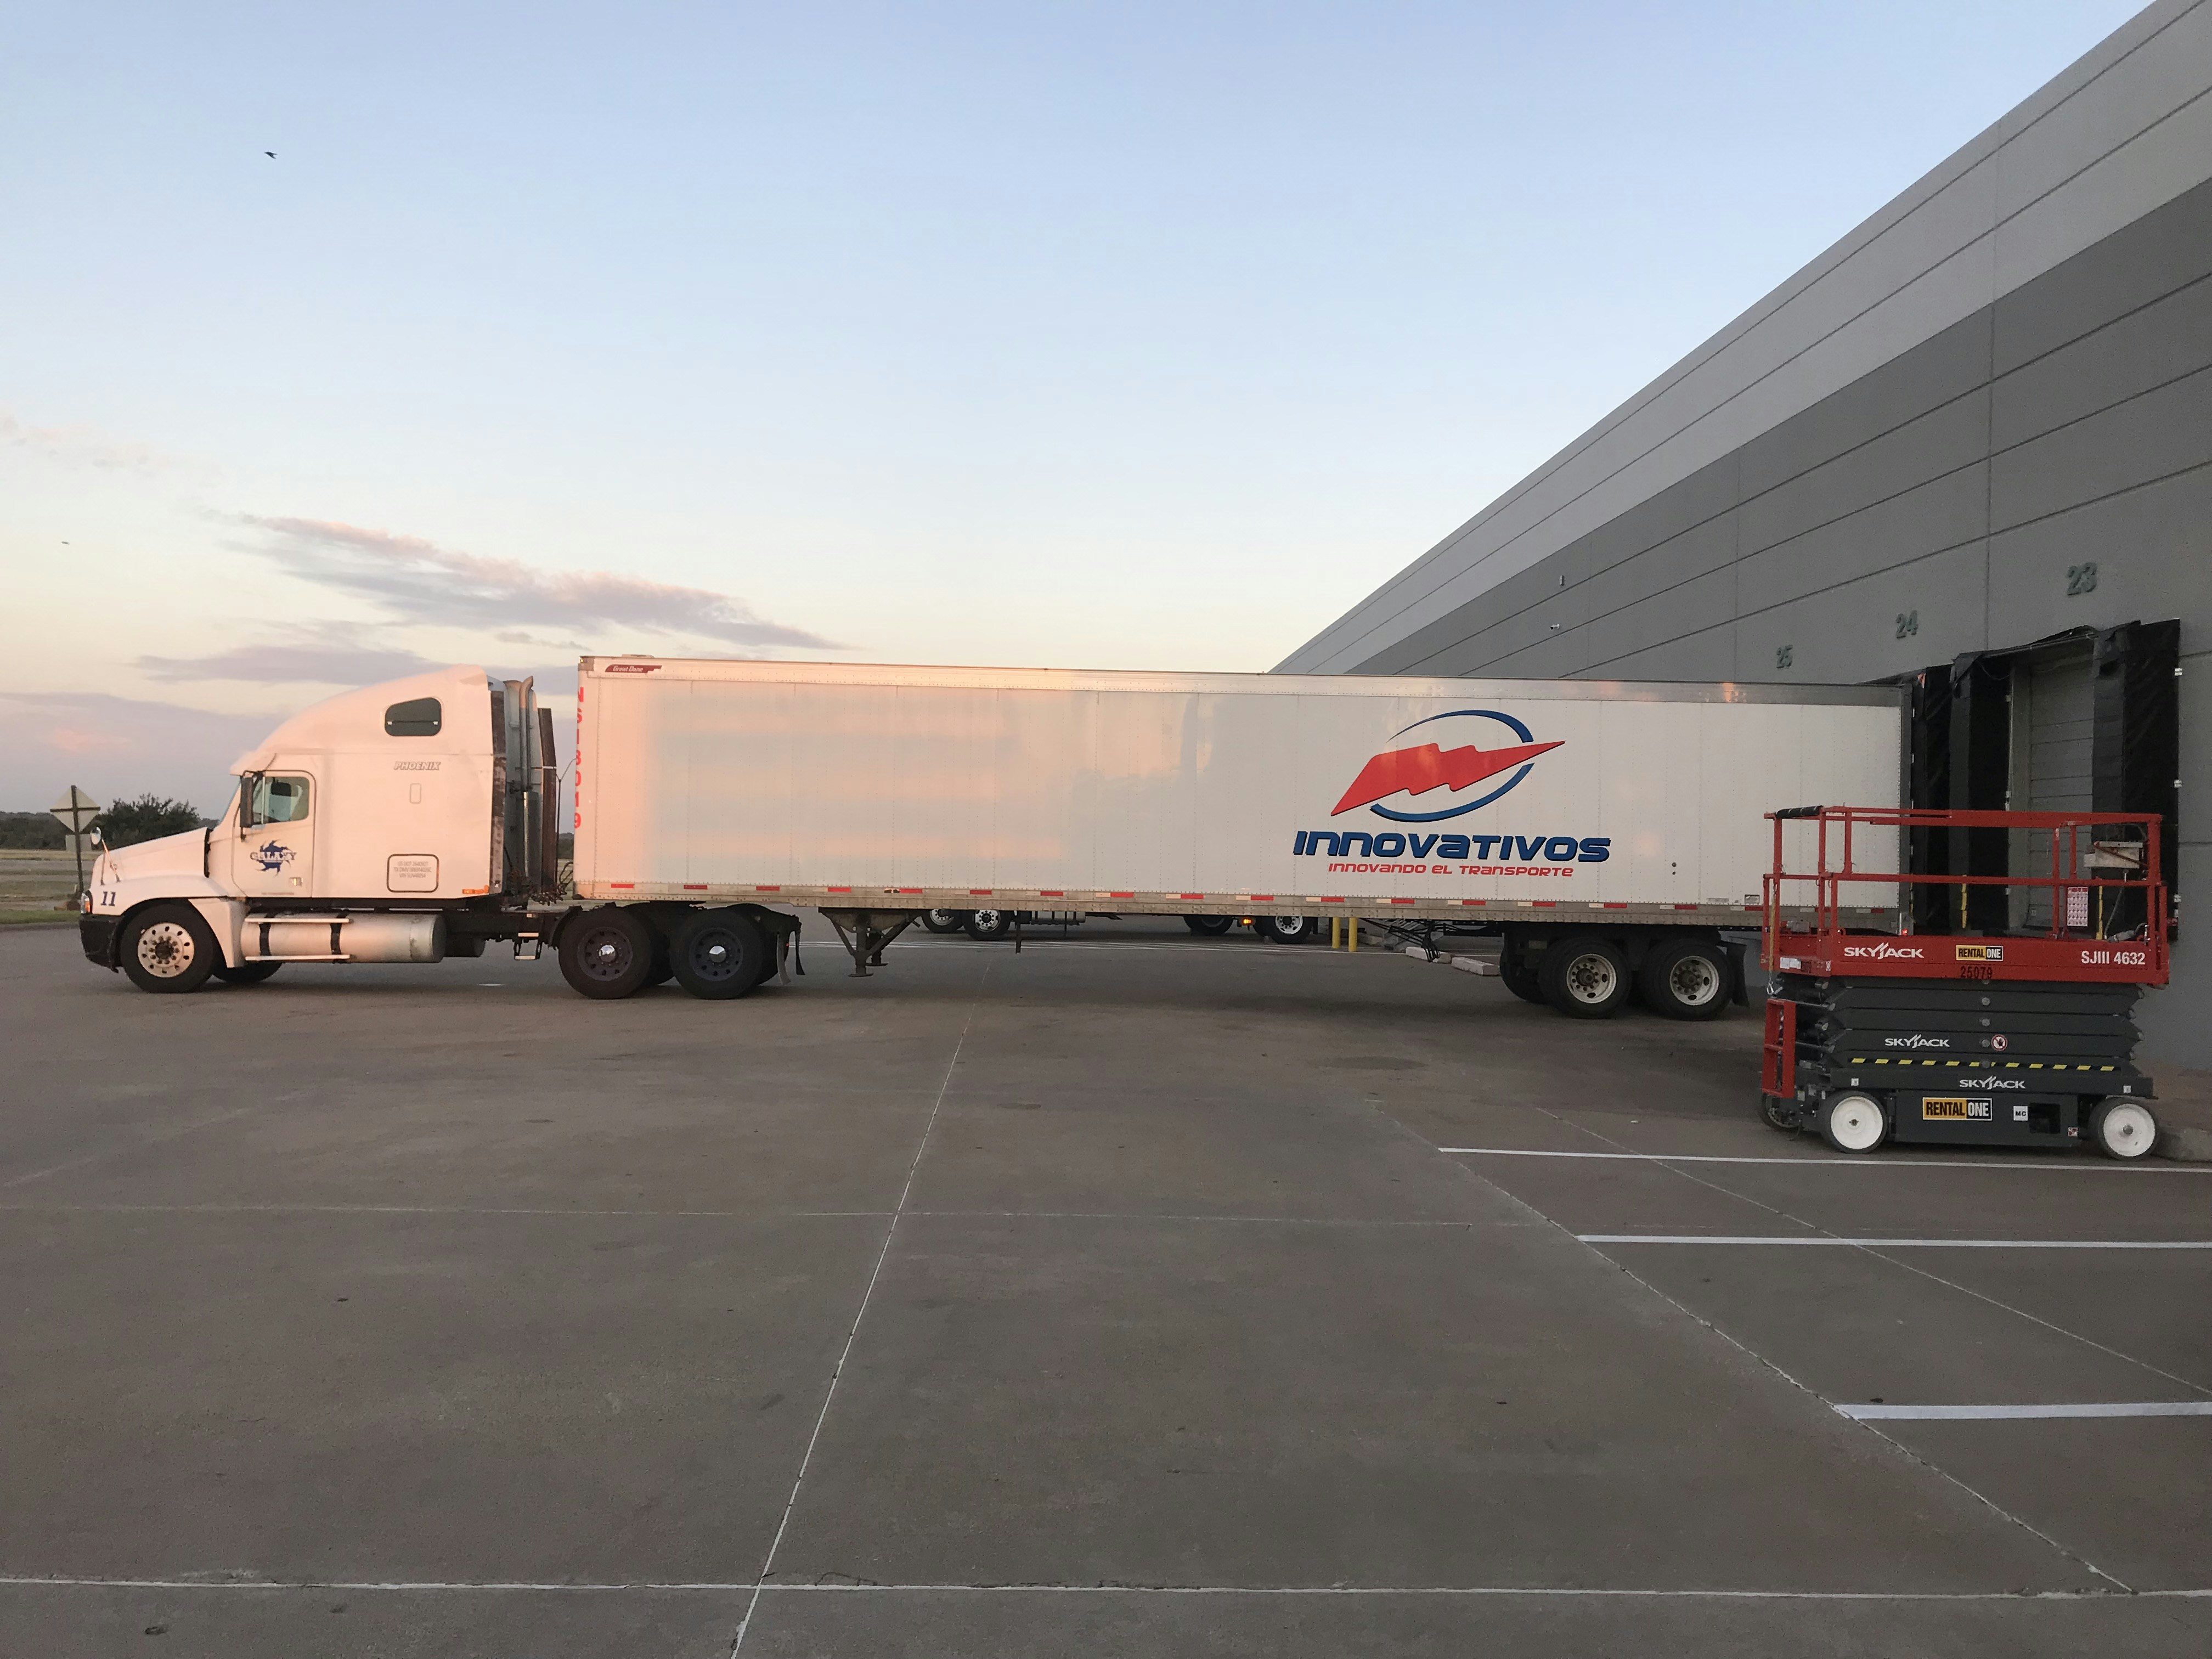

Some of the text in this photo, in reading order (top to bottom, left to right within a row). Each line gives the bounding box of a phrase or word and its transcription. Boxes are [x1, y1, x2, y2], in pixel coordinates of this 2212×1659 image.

[2067, 562, 2097, 596] 23
[1896, 610, 1918, 639] 24
[1776, 645, 1793, 668] 25
[394, 761, 441, 770] PHOENIX
[1293, 831, 1611, 862] INNOVATIVOS
[250, 851, 297, 860] GALAXY
[1328, 863, 1574, 877] INNOVANDO EL TRANSPORTE
[100, 891, 116, 906] 11
[1844, 942, 1924, 960] SKYJACK
[1958, 948, 2001, 958] RENTAL ONE
[2081, 951, 2146, 965] SJIII 4632
[1960, 966, 1993, 979] 25079
[1884, 1034, 1950, 1048] SKYJACK
[1959, 1075, 2025, 1090] SKYJACK
[1926, 1102, 1989, 1116] RENTAL ONE
